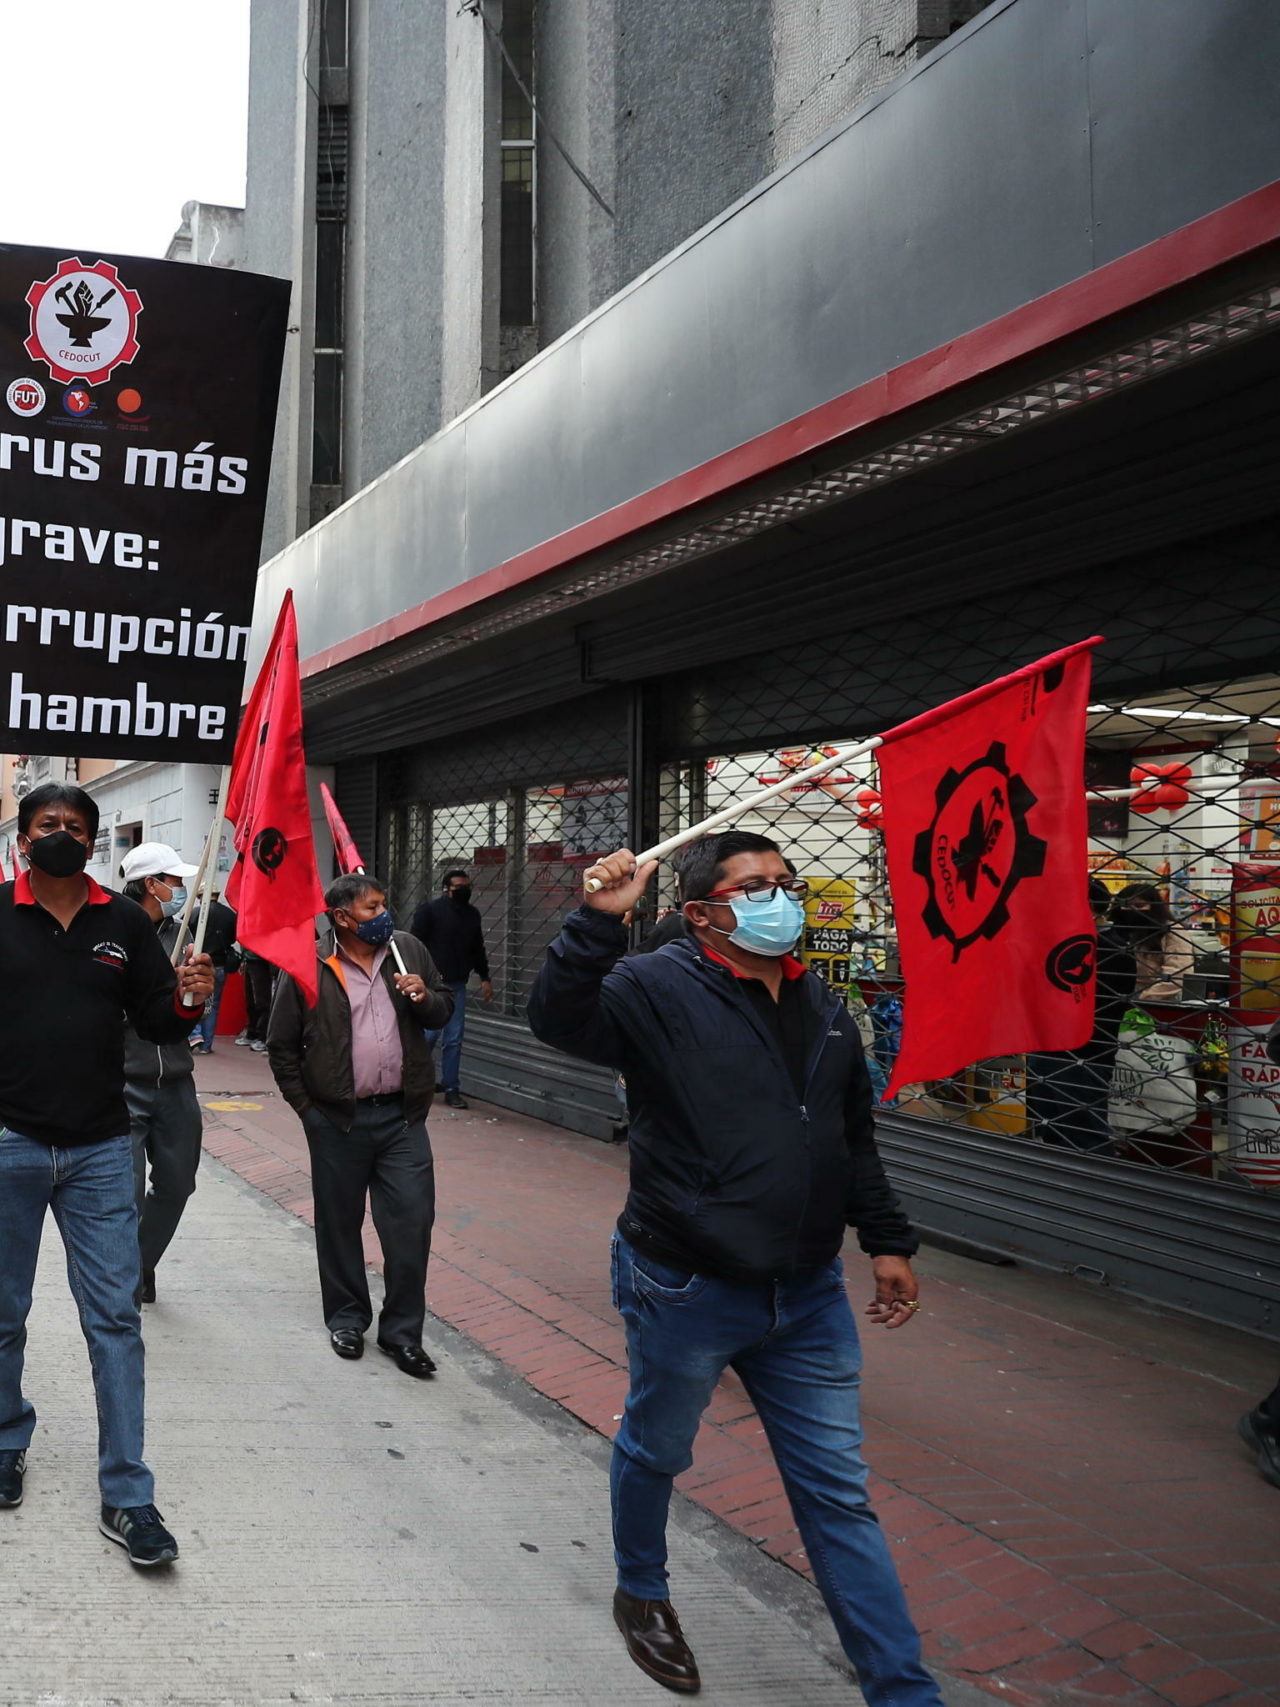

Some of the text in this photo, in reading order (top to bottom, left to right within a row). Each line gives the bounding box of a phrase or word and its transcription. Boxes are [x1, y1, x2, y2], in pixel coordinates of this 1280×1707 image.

[58, 349, 101, 363] CEDOCUT
[14, 390, 38, 404] FUT
[124, 441, 249, 496] más
[8, 672, 227, 741] hambre
[813, 928, 849, 941] PAGA
[813, 940, 849, 952] TODO
